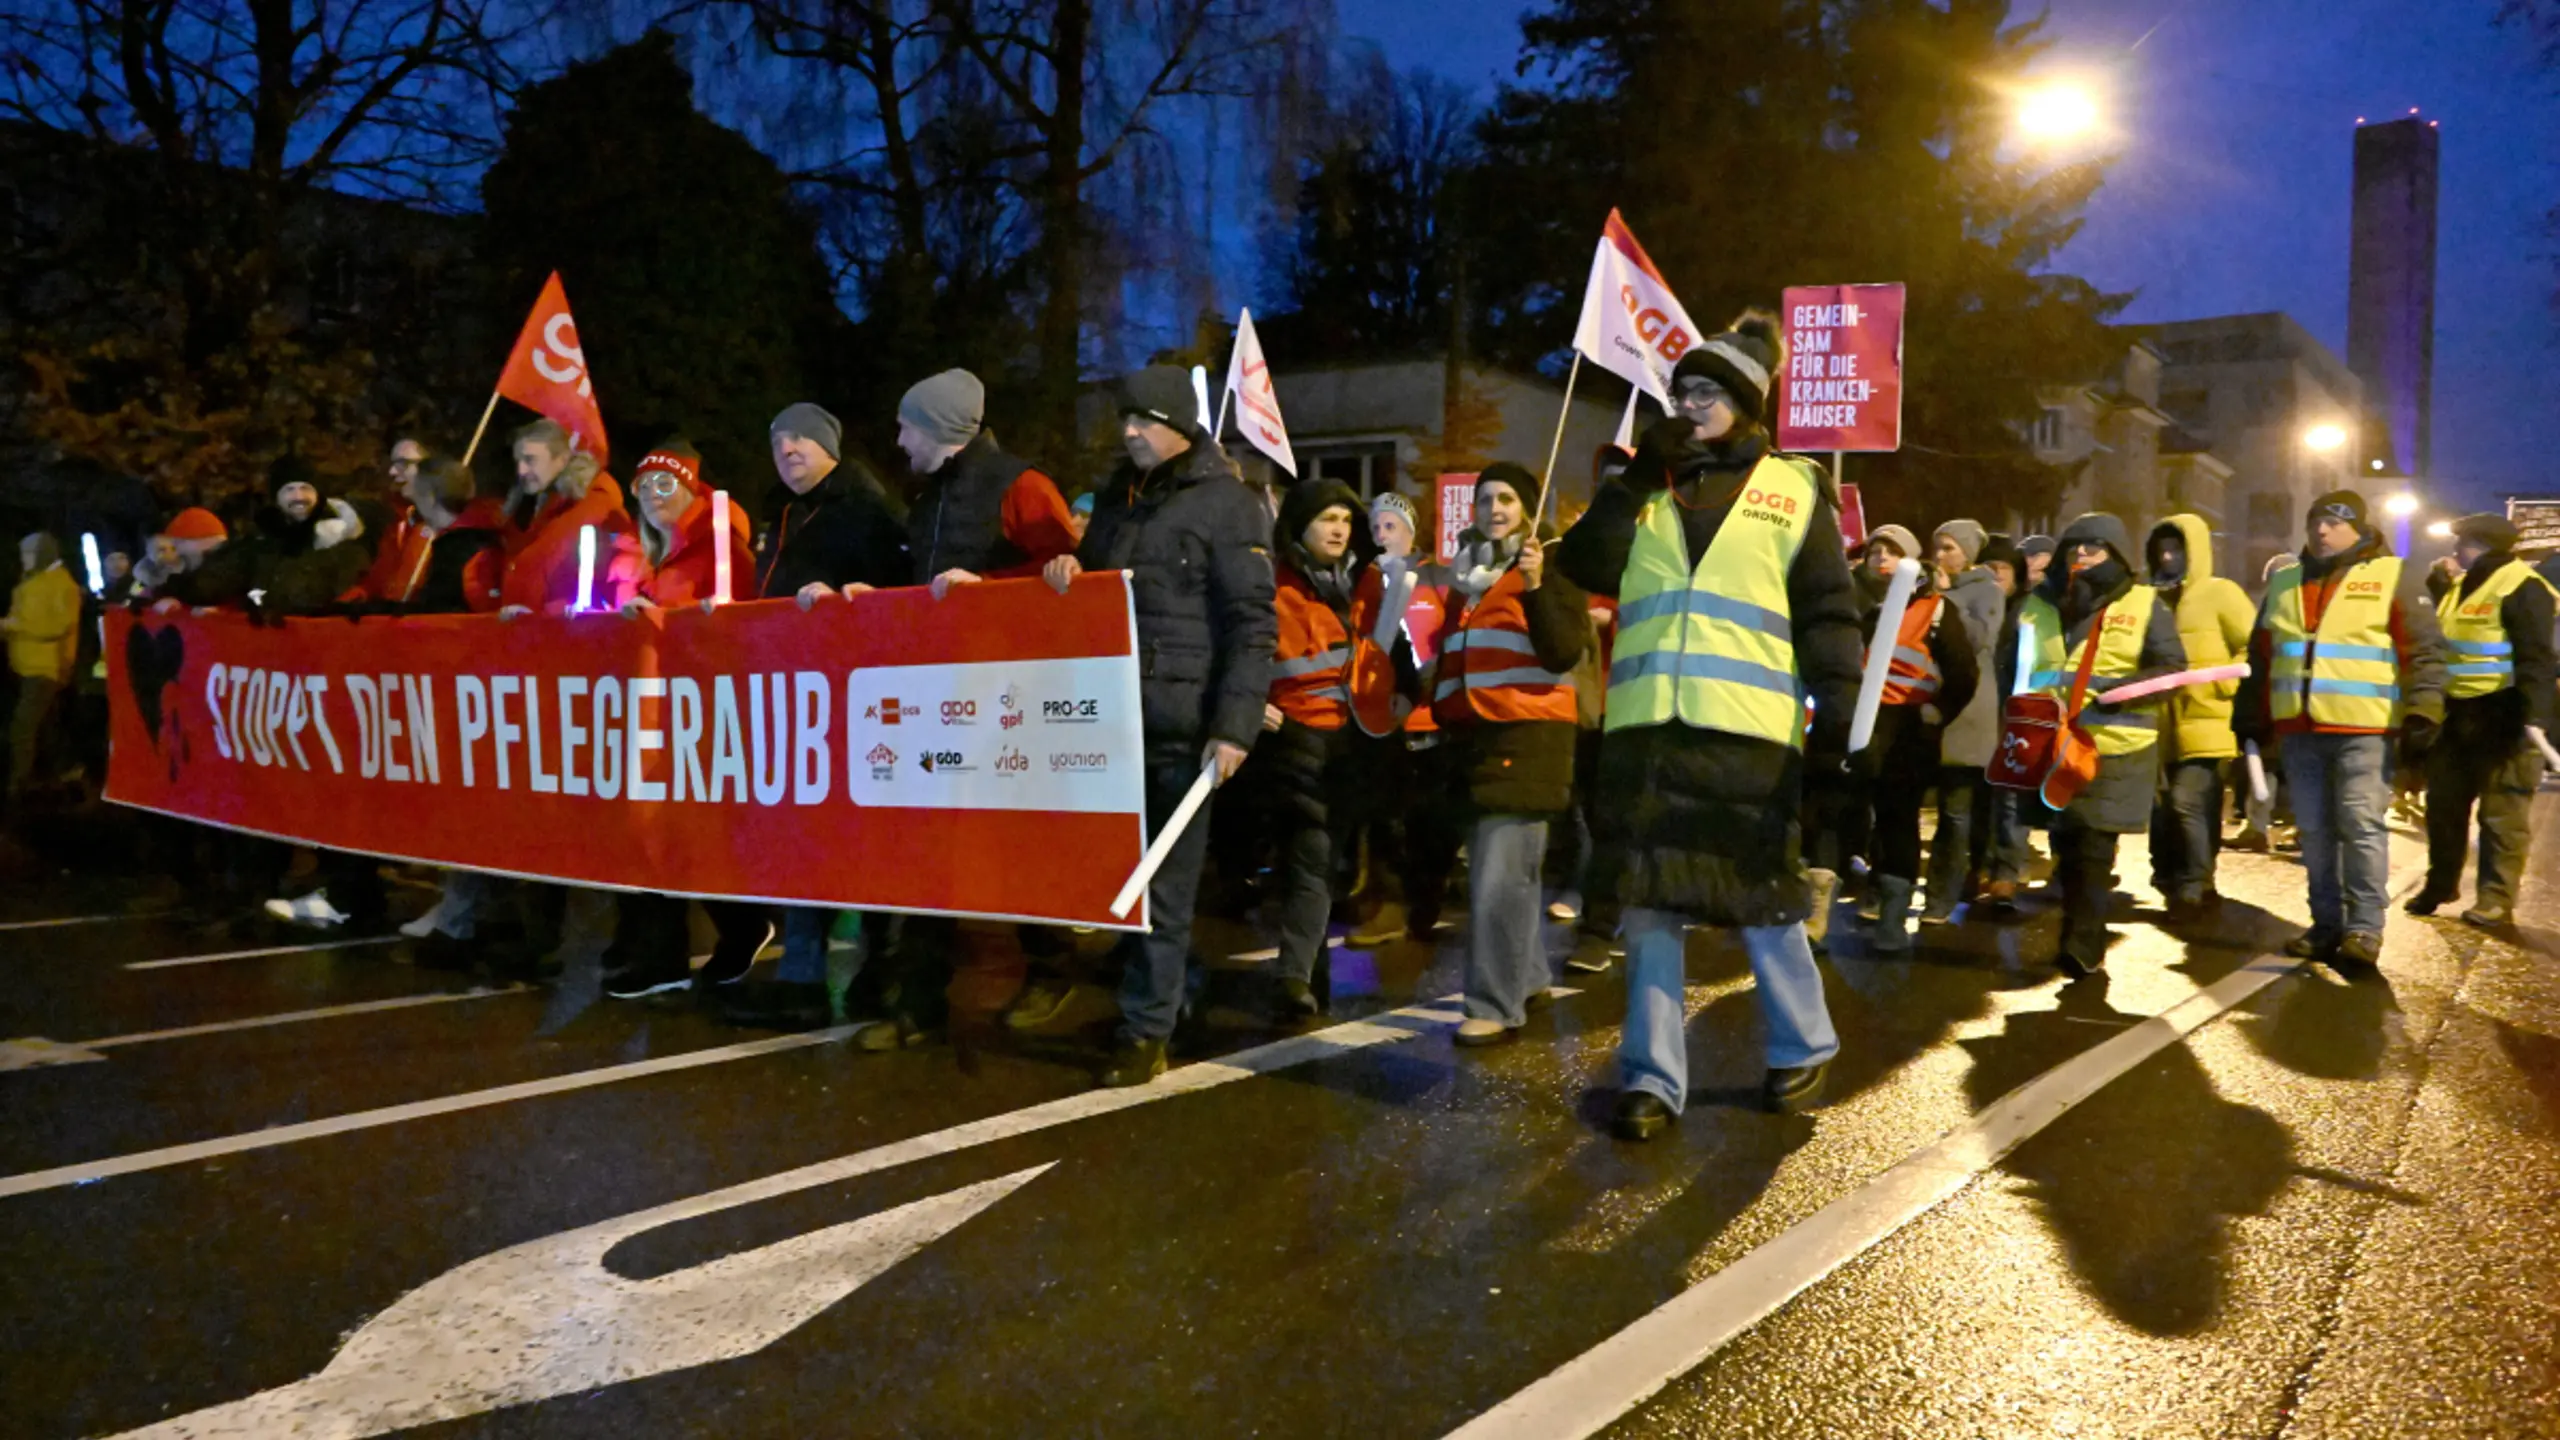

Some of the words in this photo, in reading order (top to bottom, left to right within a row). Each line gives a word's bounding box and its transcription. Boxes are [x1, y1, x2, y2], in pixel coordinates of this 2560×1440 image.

[1793, 304, 1868, 328] GEMEIN-
[1792, 329, 1832, 353] SAM
[1791, 353, 1825, 378] FÜR
[1829, 354, 1857, 378] DIE
[1790, 380, 1878, 403] KRANKEN-
[1789, 402, 1856, 427] HÄUSER
[1742, 508, 1792, 529] ORDNER
[1043, 699, 1098, 717] PRO-GE
[206, 662, 343, 775] STOPPT
[346, 673, 440, 785] DEN
[454, 670, 831, 806] PFLEGERAUB
[994, 744, 1030, 771] vida
[1049, 752, 1107, 772] younion
